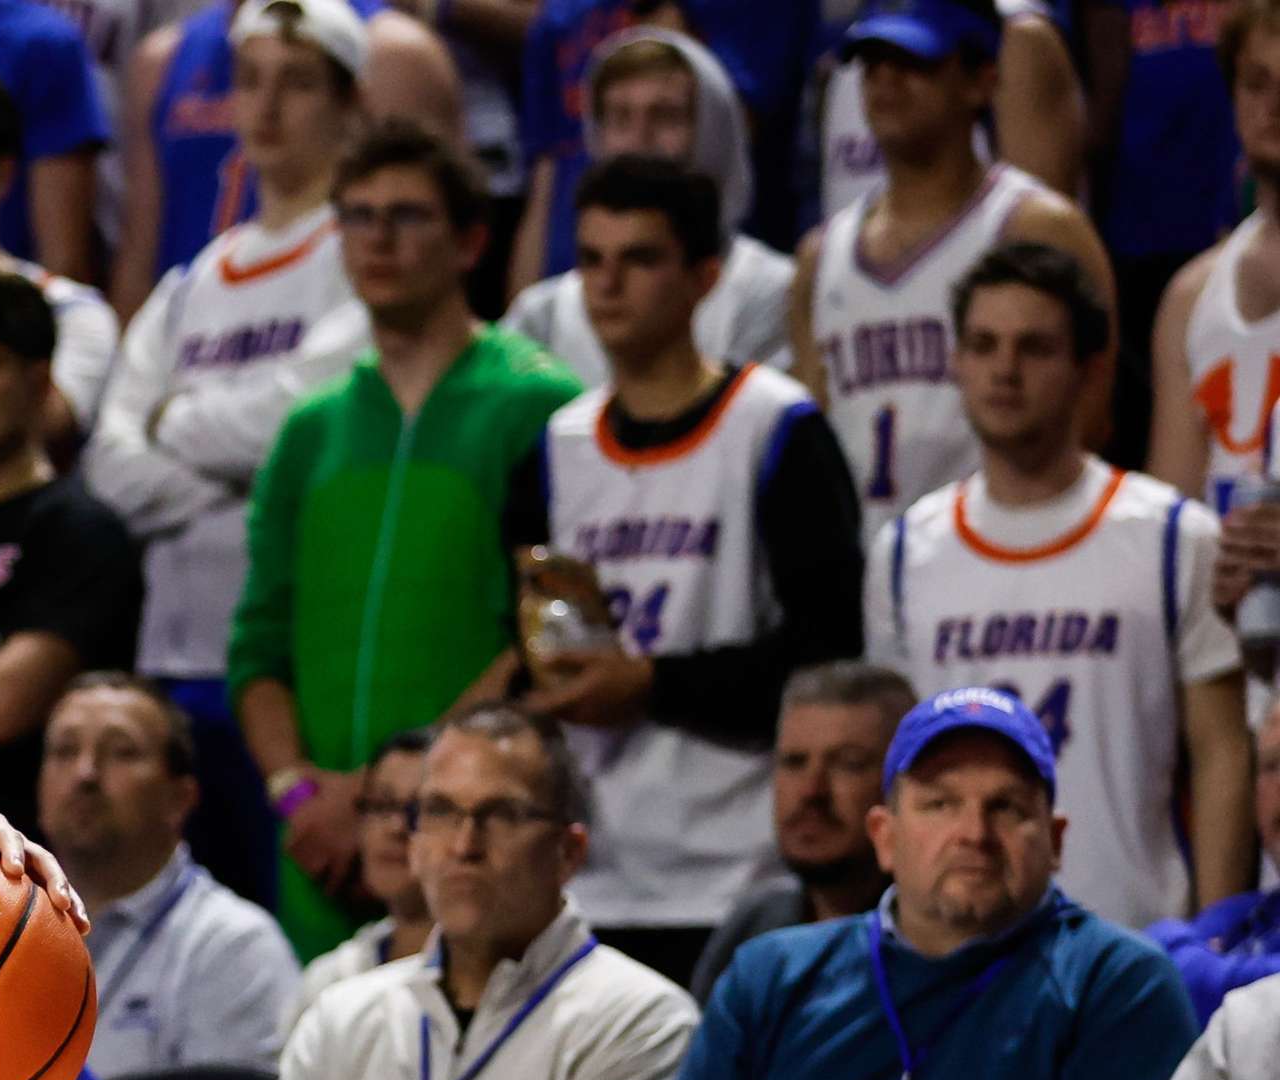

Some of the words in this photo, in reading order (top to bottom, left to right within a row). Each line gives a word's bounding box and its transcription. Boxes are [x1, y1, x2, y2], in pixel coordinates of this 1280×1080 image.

[820, 315, 958, 396] FLORID
[867, 403, 897, 501] 1
[934, 609, 1120, 666] FLORIDA
